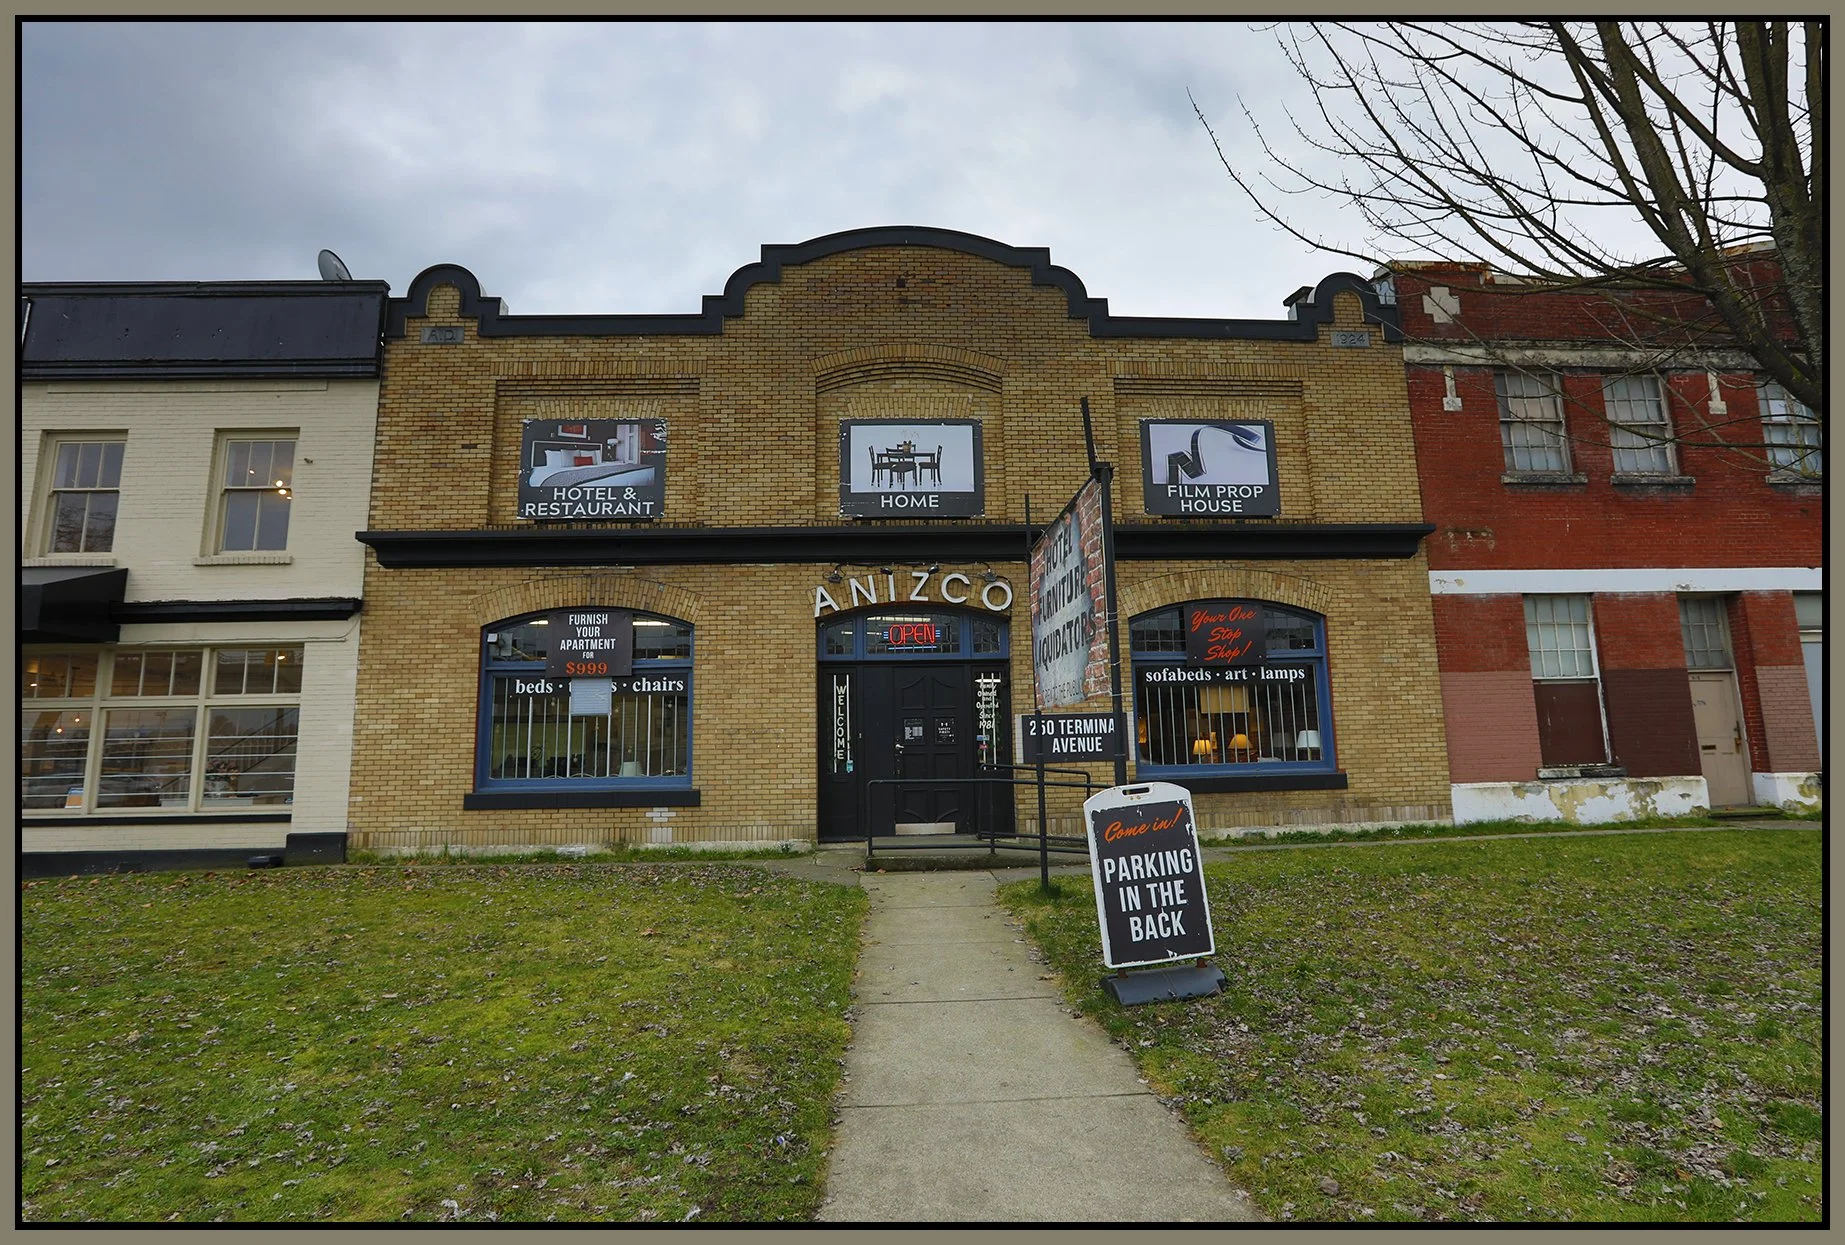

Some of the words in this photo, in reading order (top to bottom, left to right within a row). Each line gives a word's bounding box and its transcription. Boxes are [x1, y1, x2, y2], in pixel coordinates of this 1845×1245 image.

[553, 487, 617, 500] HOTEL
[623, 487, 637, 500] &
[1167, 485, 1210, 498] FILM
[1216, 485, 1263, 498] PROP
[525, 502, 654, 516] RESTAURANT
[881, 495, 939, 508] HOME
[1180, 499, 1243, 512] HOUSE
[1045, 524, 1072, 576] HOTEL
[814, 571, 1013, 618] ANIZCO
[1038, 560, 1086, 626] FURNITURE
[568, 614, 608, 625] FURNISH
[1191, 610, 1227, 632] Your
[1228, 606, 1257, 622] One
[576, 627, 600, 637] YOUR
[889, 623, 936, 644] OPEN
[1034, 605, 1096, 672] LIQUIDATORS
[1207, 626, 1242, 645] Stop
[560, 638, 616, 650] APARTMENT
[1204, 640, 1253, 664] Shop!
[582, 651, 594, 659] FOR
[566, 661, 608, 676] $999
[1145, 667, 1212, 682] sofabeds
[1225, 668, 1248, 681] art
[1260, 666, 1305, 683] lamps
[515, 679, 553, 694] beds
[632, 677, 684, 692] chairs
[836, 685, 847, 760] WELCOME
[1058, 718, 1115, 735] TERMINA
[1052, 737, 1103, 753] AVENUE
[1104, 821, 1150, 844] Come
[1152, 808, 1183, 832] in!
[1103, 848, 1194, 884] PARKING
[1118, 885, 1142, 912] IN
[1146, 879, 1187, 909] THE
[1129, 910, 1187, 942] BACK
